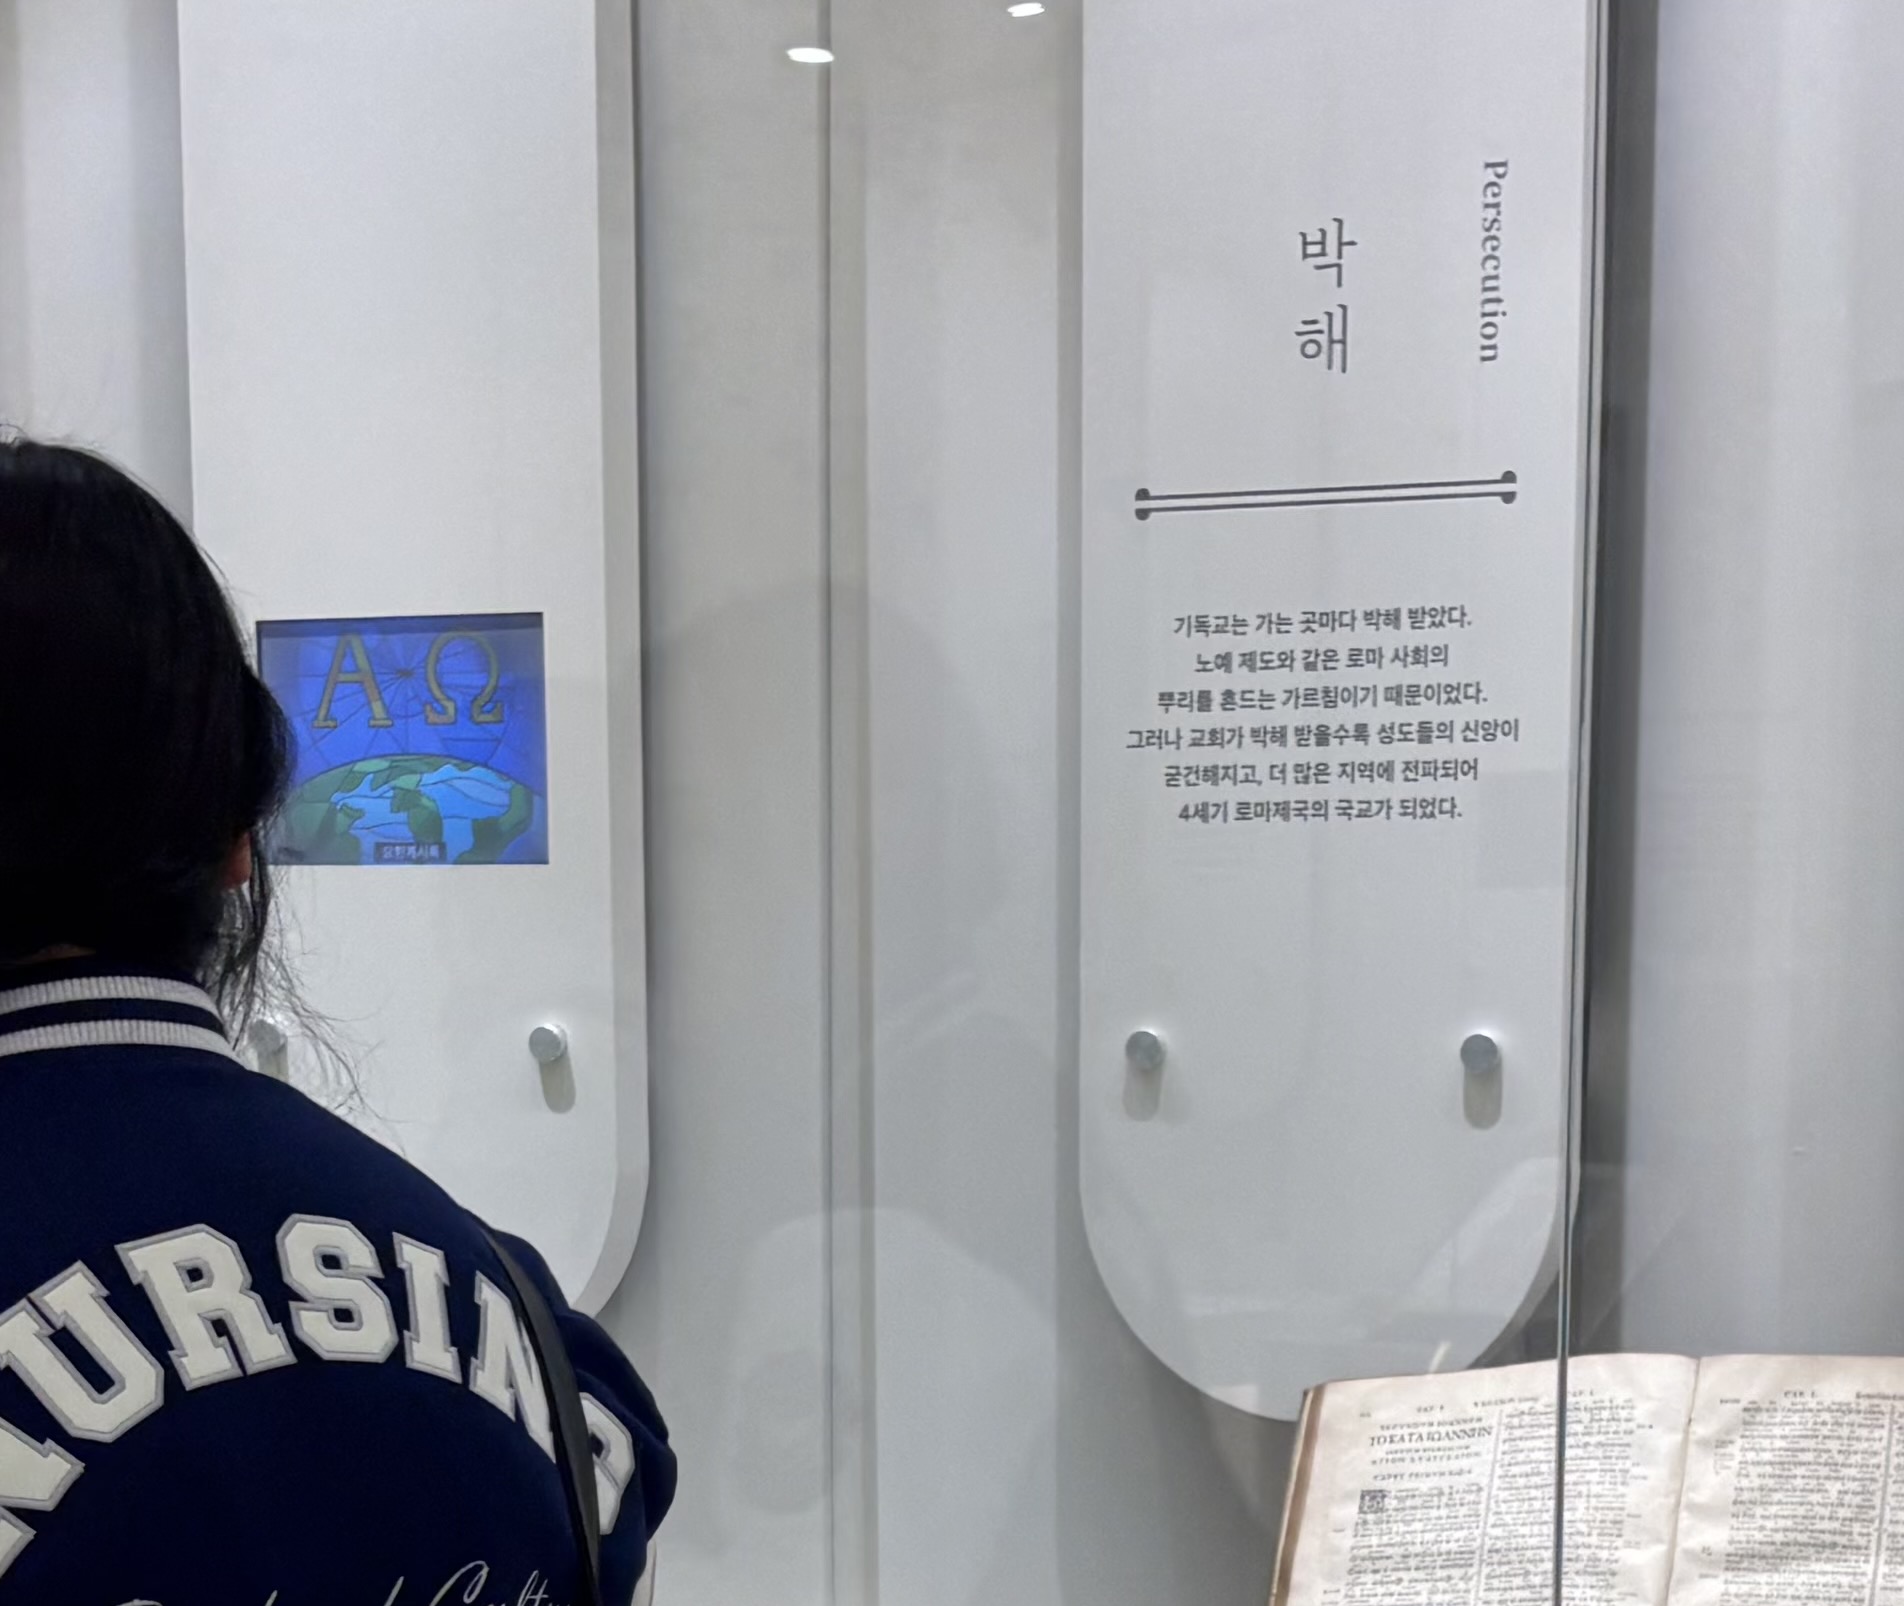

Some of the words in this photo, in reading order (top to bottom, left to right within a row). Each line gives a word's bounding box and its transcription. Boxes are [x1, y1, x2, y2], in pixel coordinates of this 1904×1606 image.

[1479, 159, 1509, 363] Persecution
[1294, 217, 1358, 374] 박해
[1174, 614, 1248, 637] 기독교는
[1255, 612, 1294, 635] 가는
[1298, 610, 1357, 634] 곳마다
[1363, 608, 1402, 631] 박해
[1408, 605, 1472, 630] 받았다.
[1194, 651, 1233, 674] 노예
[1238, 650, 1295, 673] 제도와
[1301, 647, 1340, 671] 같은
[1345, 646, 1384, 670] 로마
[1390, 644, 1449, 668] 사회의
[424, 630, 505, 725] Ω
[1157, 690, 1213, 714] 뿌리를
[1219, 689, 1276, 712] 흔드는
[1282, 685, 1378, 710] 가르침이기
[1384, 682, 1488, 707] 때문이었다.
[1126, 729, 1182, 750] 그러나
[1188, 726, 1244, 749] 교회가
[1249, 725, 1288, 748] 박해
[1294, 722, 1370, 747] 받을수록
[1377, 720, 1454, 745] 성도들의
[1461, 718, 1519, 742] 신앙이
[1164, 763, 1263, 787] 굳건해지고,
[1269, 762, 1287, 785] 더
[1293, 762, 1331, 785] 많은
[1338, 760, 1394, 783] 지역에
[1401, 757, 1479, 782] 전파되어
[1179, 801, 1228, 824] 4세기
[1234, 799, 1329, 823] 로마제국의
[1335, 798, 1392, 821] 국교가
[1399, 796, 1462, 820] 되었다.
